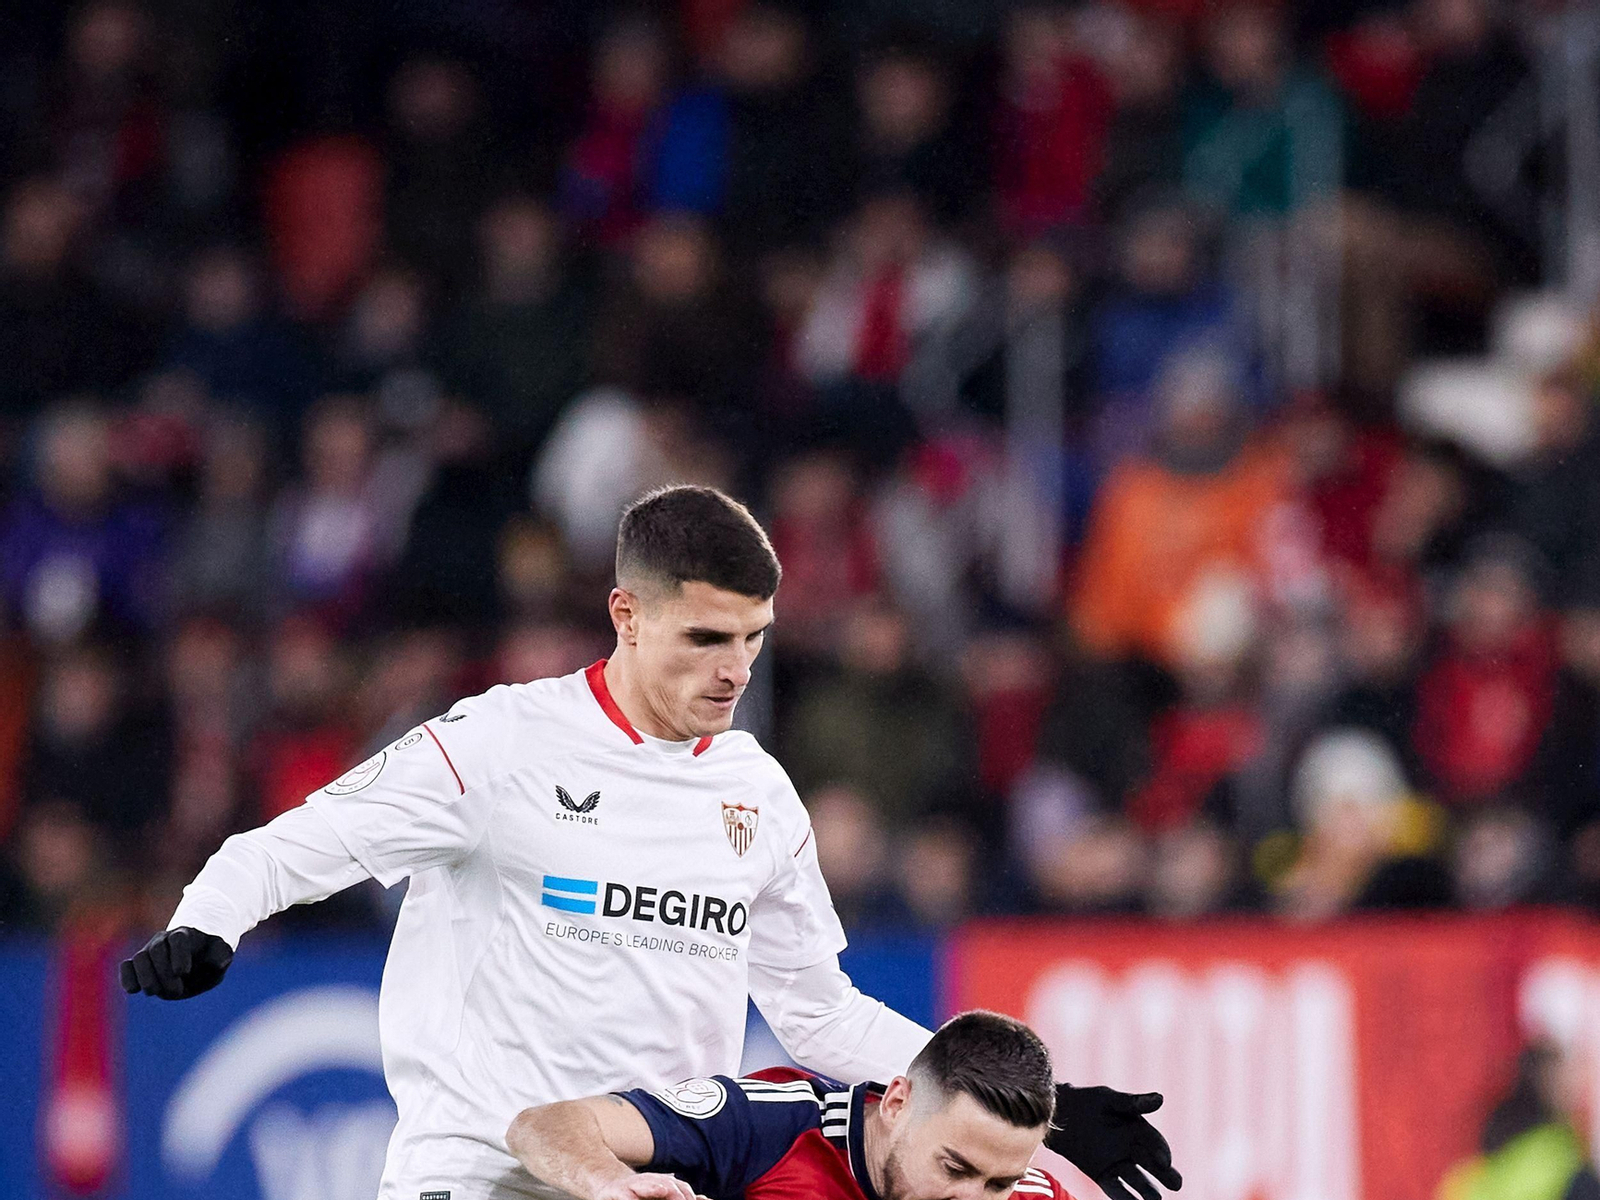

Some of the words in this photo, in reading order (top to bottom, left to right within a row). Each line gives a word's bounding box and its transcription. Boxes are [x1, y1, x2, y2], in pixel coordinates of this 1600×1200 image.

[555, 812, 598, 825] CASTORE
[602, 882, 748, 936] DEGIRO
[625, 932, 685, 954] LEADING
[688, 943, 739, 961] BROKER
